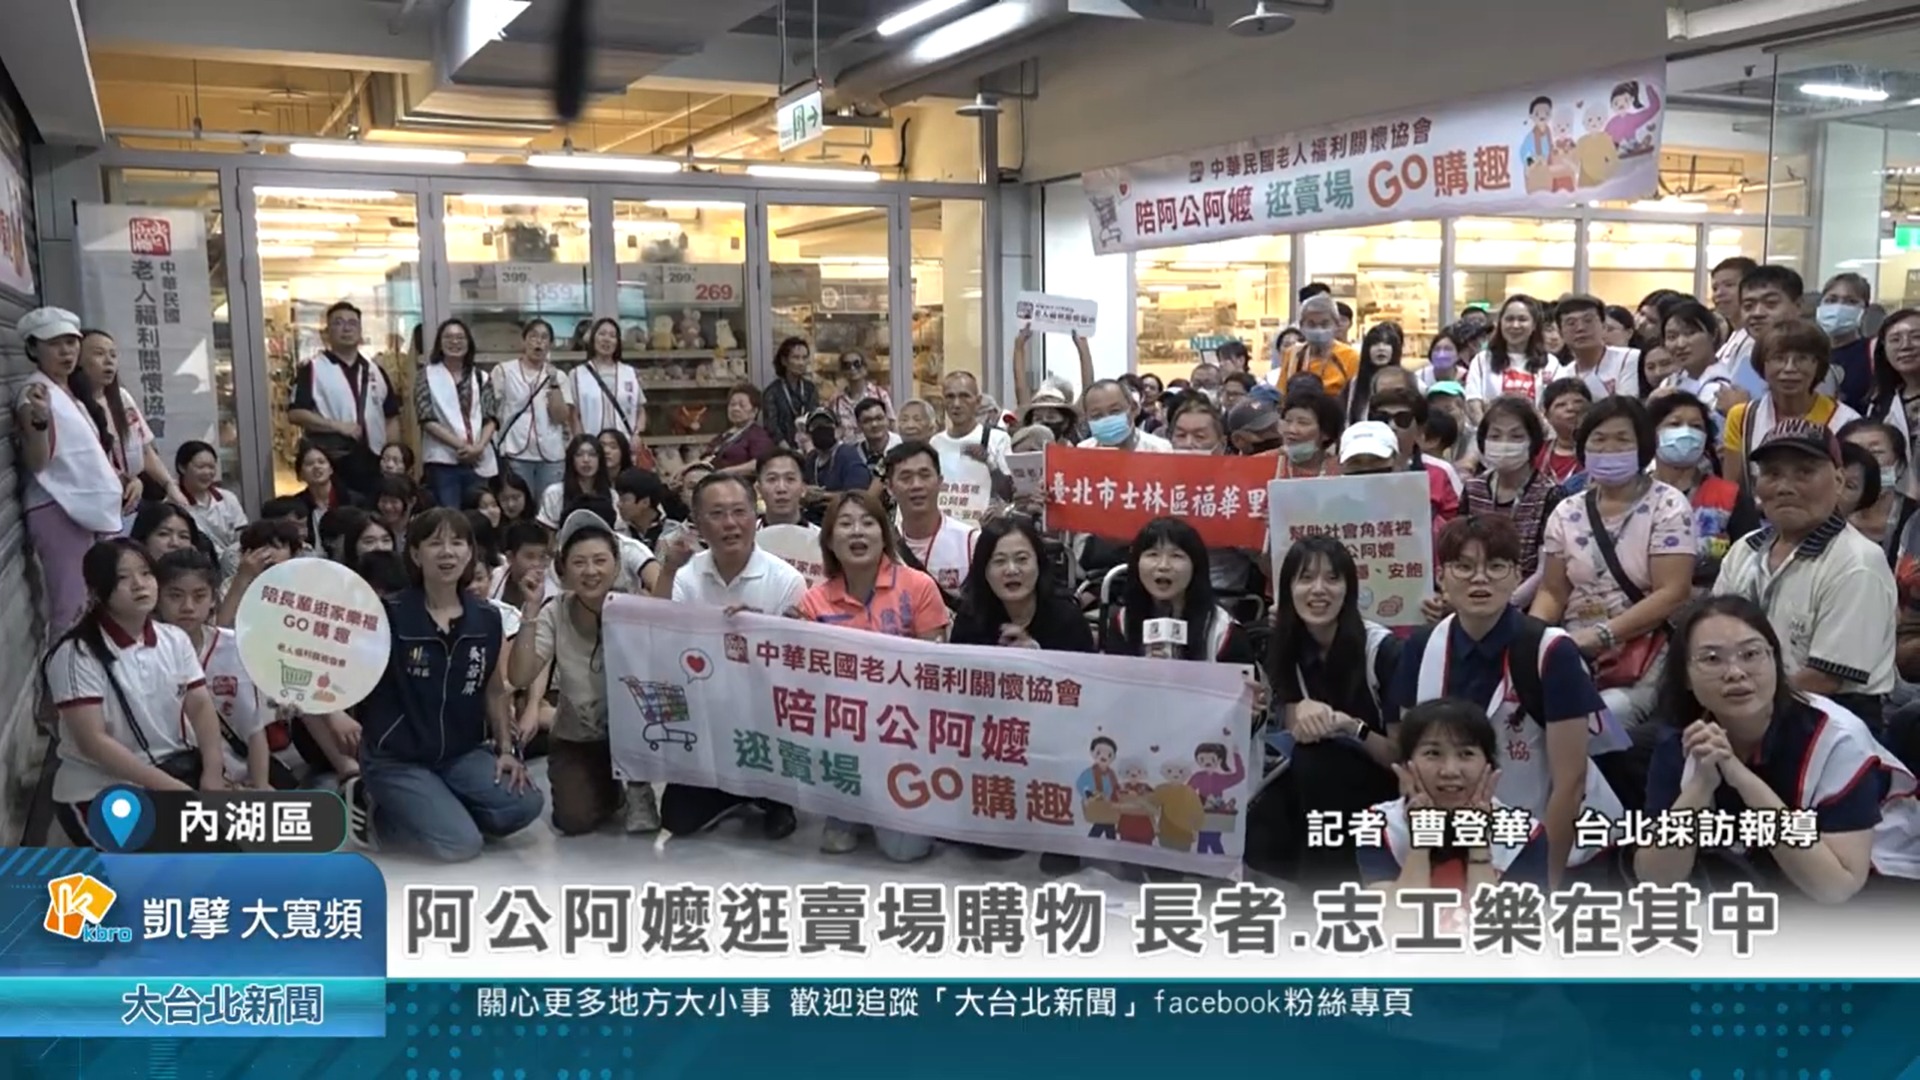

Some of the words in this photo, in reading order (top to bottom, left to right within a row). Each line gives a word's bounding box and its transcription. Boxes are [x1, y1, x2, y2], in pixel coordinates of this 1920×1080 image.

[1211, 117, 1432, 180] 中華民國老人福利關懷協會
[1135, 185, 1254, 235] 陪阿公阿嬤
[1265, 168, 1354, 219] 逛賣場
[160, 260, 181, 325] 中華民國
[695, 284, 732, 300] 269
[131, 260, 166, 438] 老人福利關懷協會
[1049, 471, 1267, 519] 臺北市士林區福華里
[1289, 520, 1413, 541] 幫助社會角落裡
[261, 585, 379, 631] 陪長輩逛家樂福
[756, 641, 1082, 707] 中華民國老人福利關懷協會
[772, 686, 1031, 767] 陪阿公阿嬤
[733, 729, 862, 797] 逛賣場
